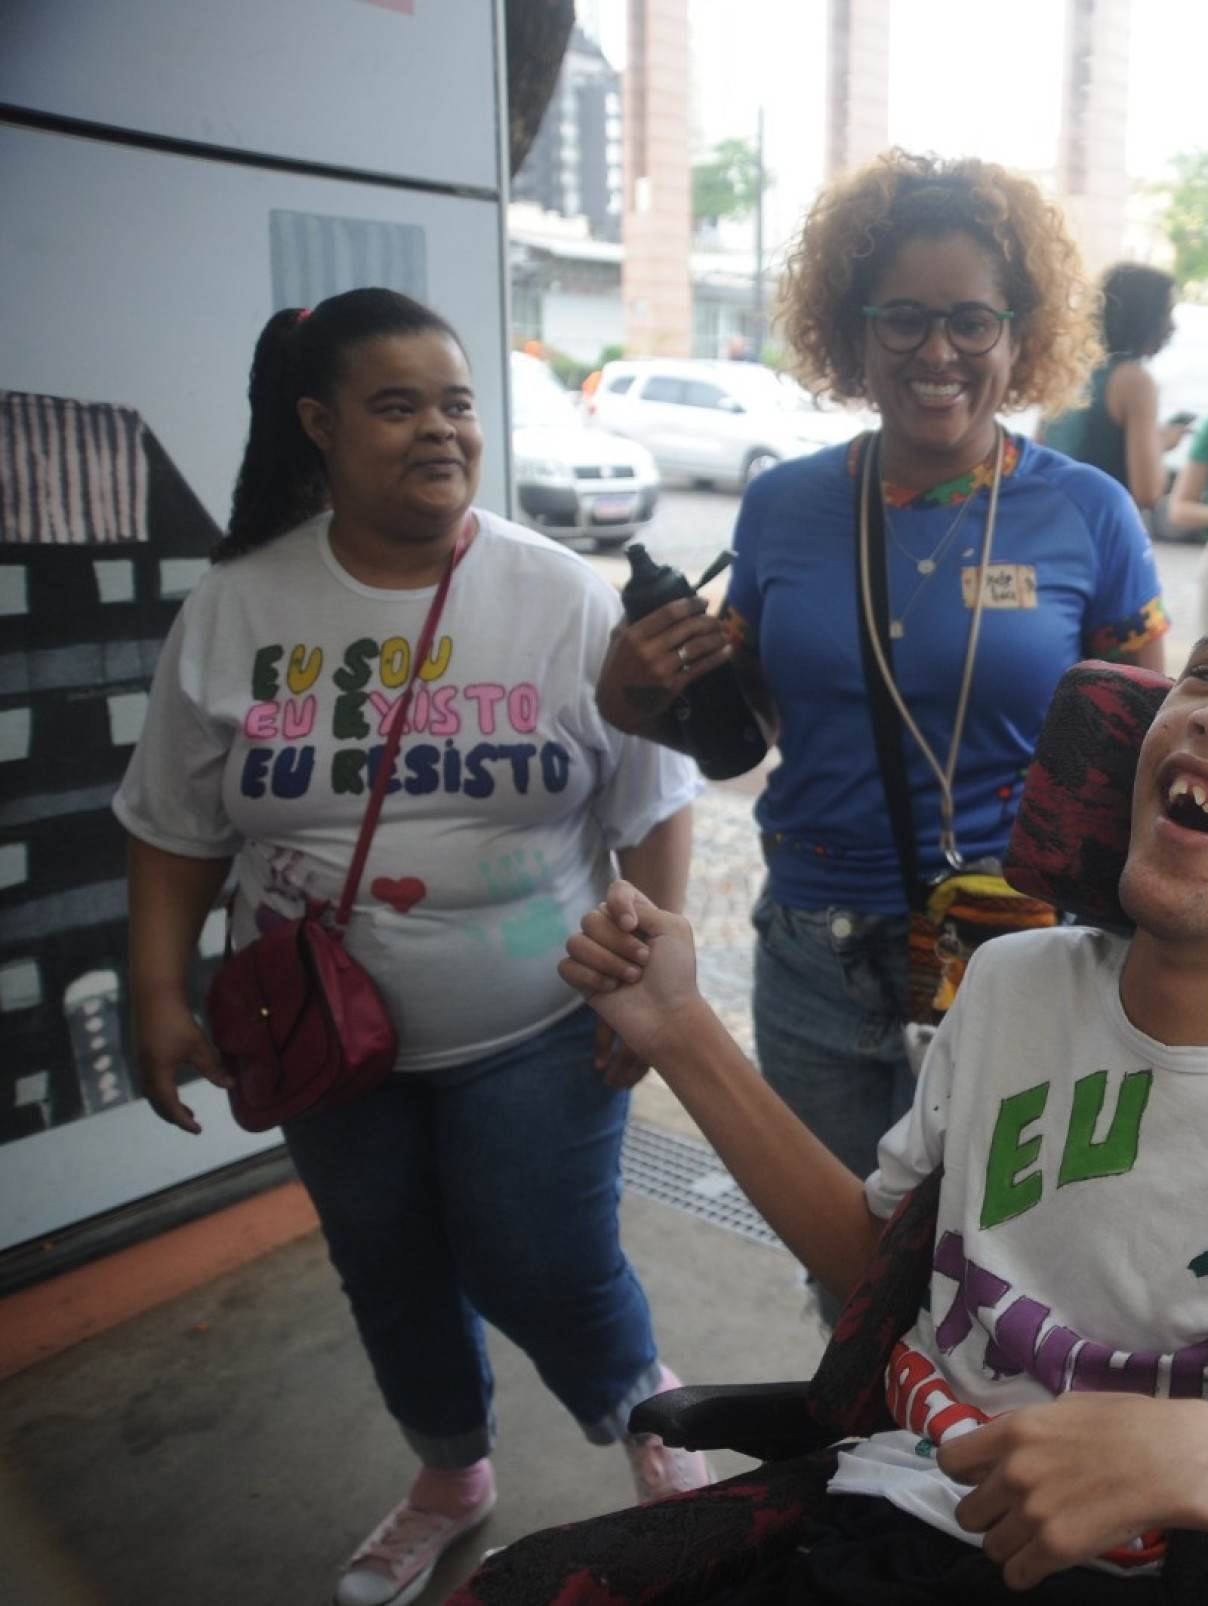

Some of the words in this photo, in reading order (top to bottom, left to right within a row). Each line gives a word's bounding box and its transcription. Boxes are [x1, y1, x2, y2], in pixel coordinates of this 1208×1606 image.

[252, 643, 323, 700] EU
[332, 635, 454, 691] SOU
[245, 694, 317, 739] EU
[332, 682, 539, 739] EXISTO
[241, 745, 315, 798] EU
[979, 1069, 1153, 1231] EU
